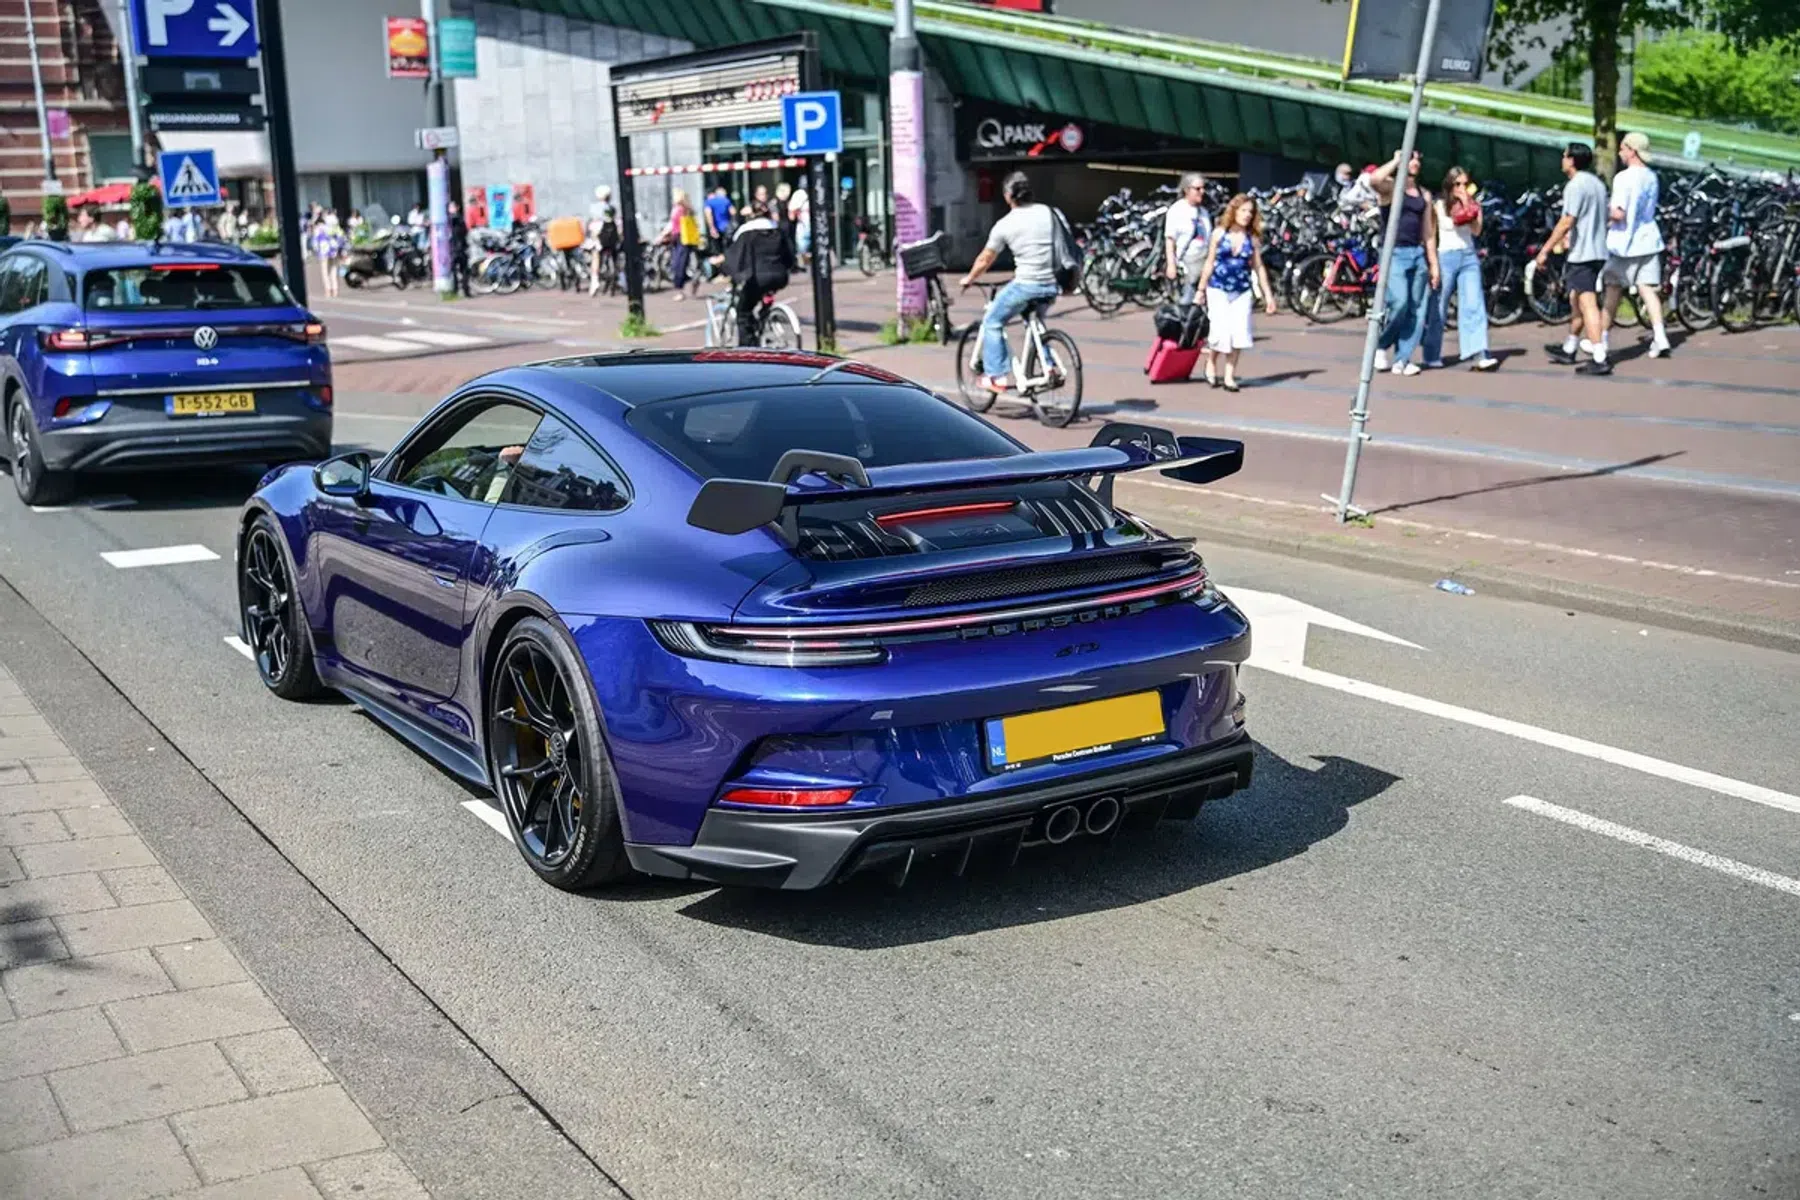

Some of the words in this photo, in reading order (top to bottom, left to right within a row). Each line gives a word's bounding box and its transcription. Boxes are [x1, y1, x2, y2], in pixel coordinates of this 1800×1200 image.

[794, 102, 828, 147] P
[176, 394, 249, 410] T-552-GB
[991, 745, 1006, 758] NL
